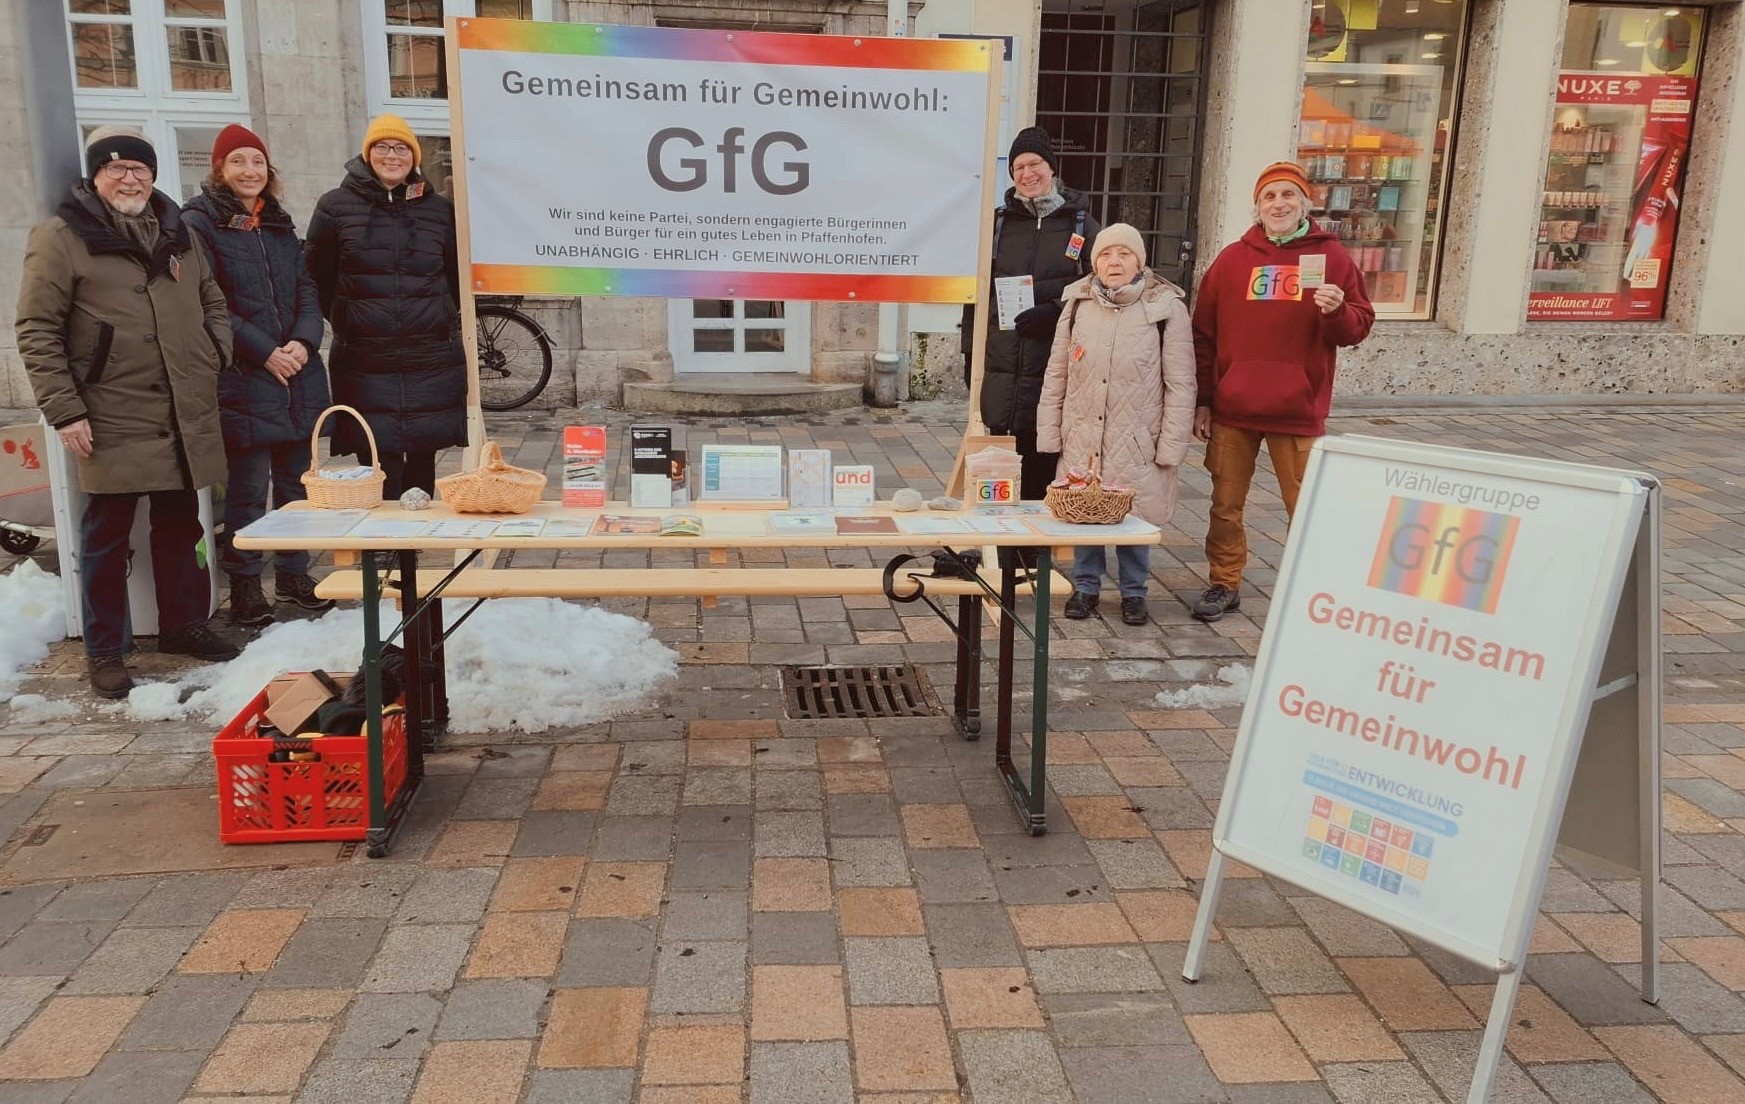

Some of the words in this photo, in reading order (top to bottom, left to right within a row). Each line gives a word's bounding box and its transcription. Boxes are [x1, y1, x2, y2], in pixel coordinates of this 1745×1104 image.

[502, 70, 687, 102] Gemeinsam
[699, 78, 742, 104] für
[753, 82, 949, 112] Gemeinwohl:
[1557, 79, 1622, 95] NUXE
[646, 126, 811, 196] GfG
[549, 207, 572, 220] Wir
[576, 208, 605, 222] sind
[609, 210, 646, 223] keine
[650, 211, 693, 225] Partei,
[696, 213, 751, 226] sondern
[754, 215, 824, 230] engagierte
[827, 216, 908, 231] Bürgerinnen
[574, 225, 600, 237] und
[604, 225, 651, 241] Bürger
[654, 227, 674, 240] für
[677, 228, 697, 240] ein
[701, 229, 738, 243] gutes
[741, 230, 781, 242] Leben
[785, 231, 797, 242] in
[801, 231, 887, 245] Pfaffenhofen.
[535, 244, 640, 260] UNABHÄNGIG
[653, 248, 719, 261] EHRLICH
[732, 250, 920, 267] GEMEINWOHLORIENTIERT
[1251, 271, 1300, 296] GfG
[1591, 298, 1614, 309] LIFT
[835, 470, 871, 484] und
[979, 484, 1011, 501] GfG
[1384, 467, 1541, 511] Wählergruppe
[1387, 523, 1500, 586] GfG
[1307, 592, 1546, 680] Gemeinsam
[1377, 660, 1436, 703] für
[1278, 684, 1527, 789] Gemeinwohl
[1348, 765, 1464, 817] ENTWICKLUNG
